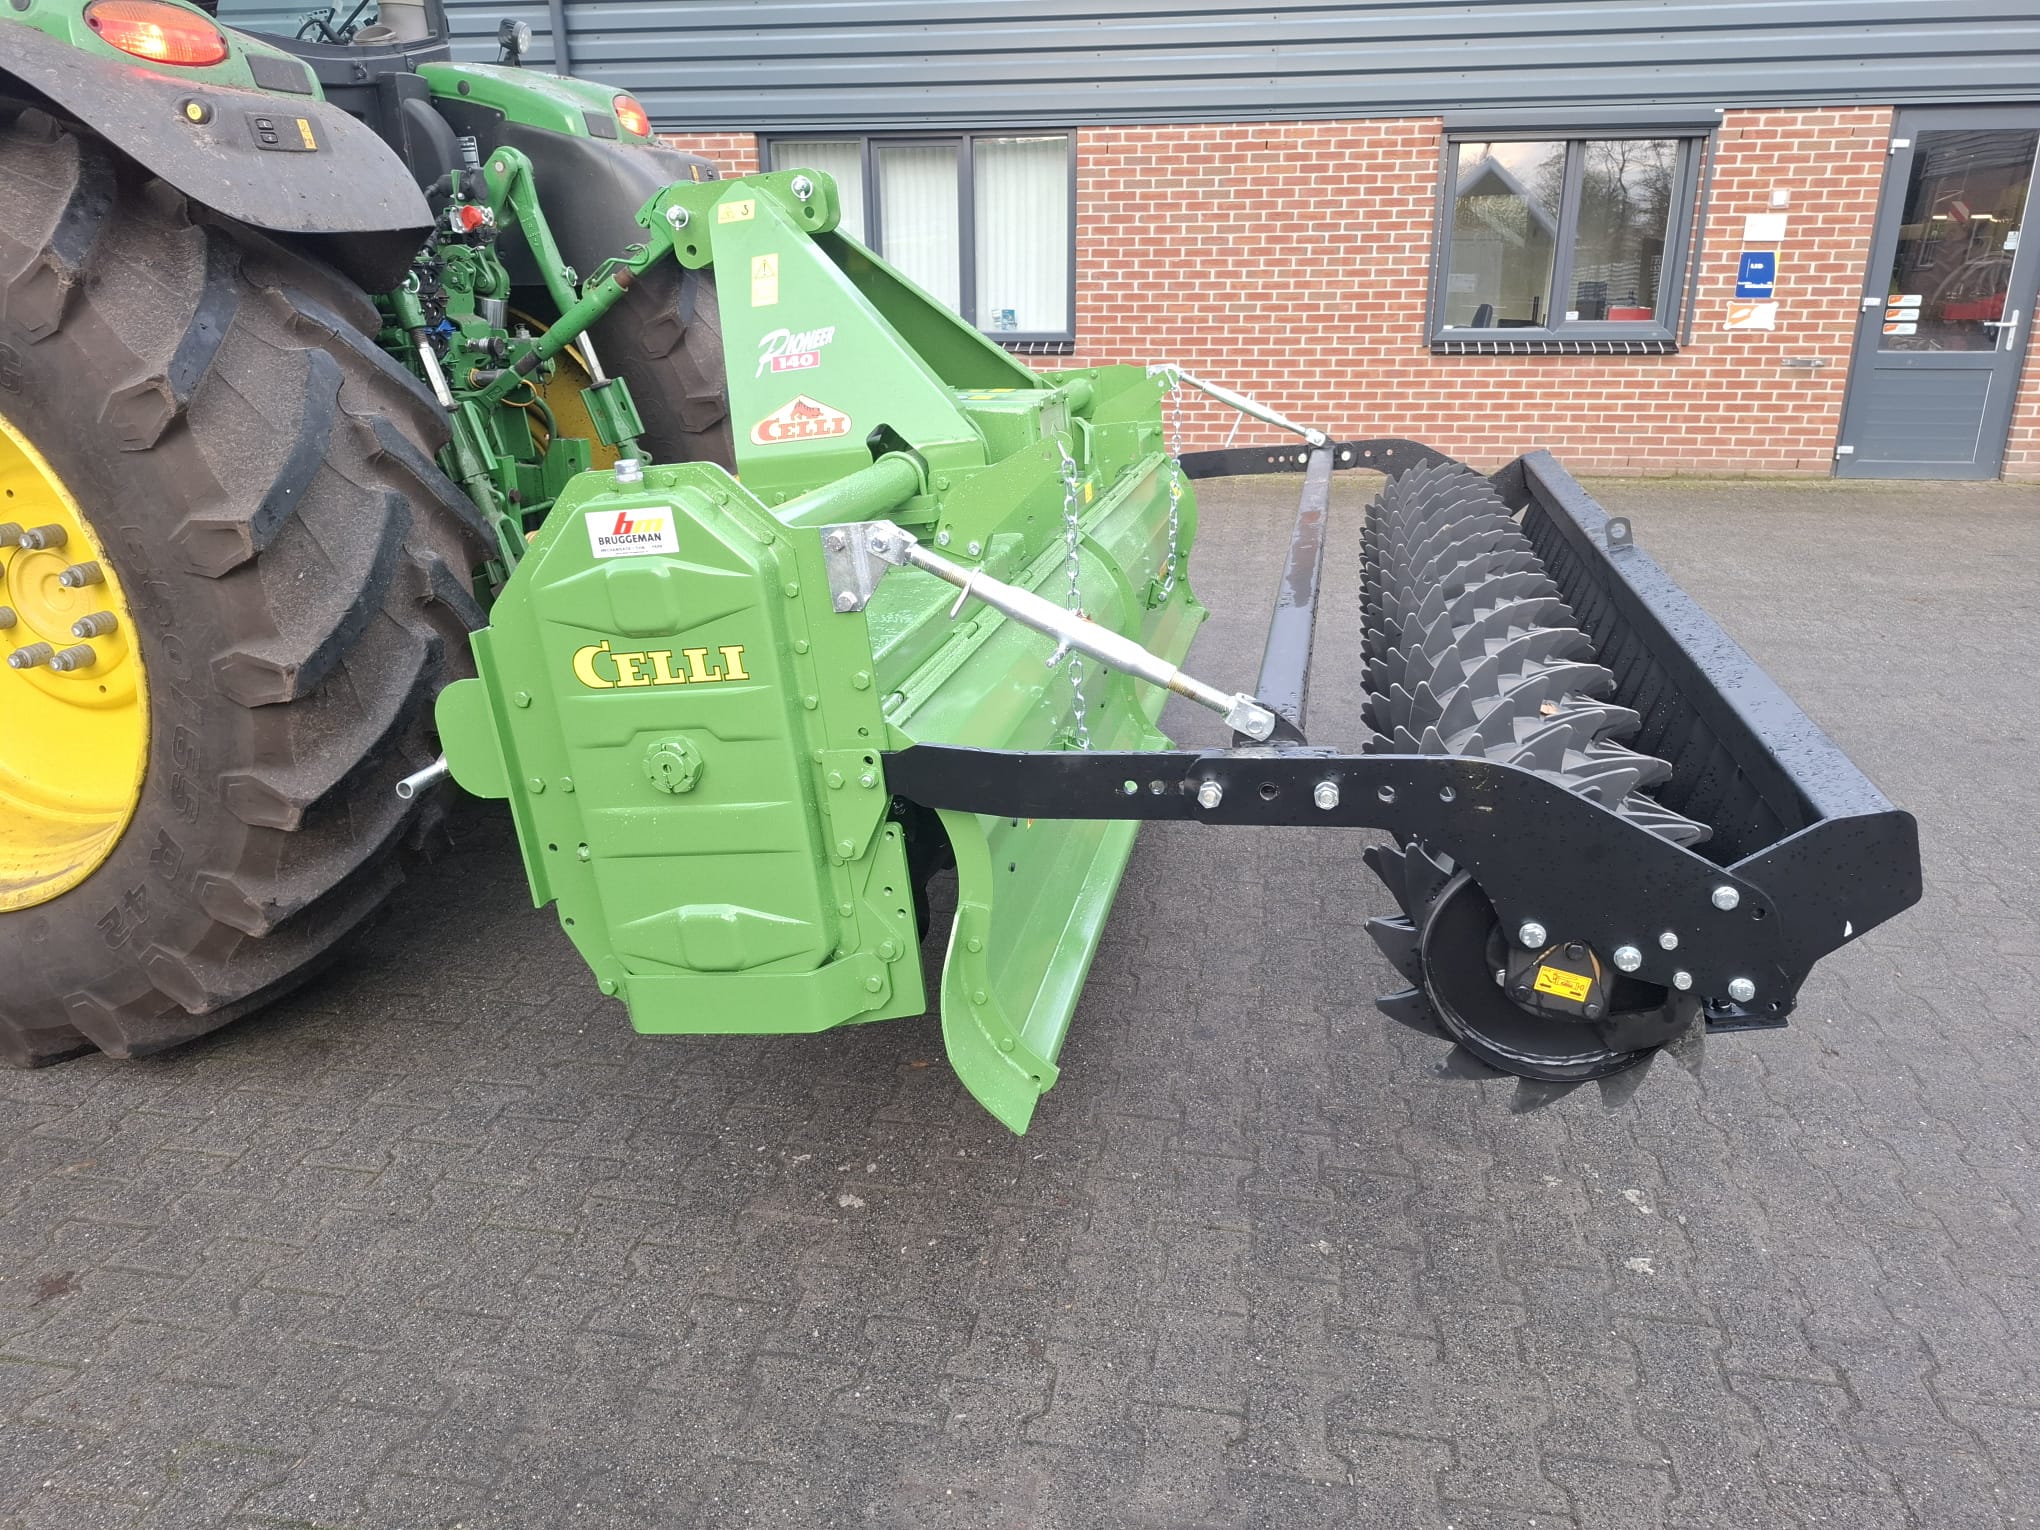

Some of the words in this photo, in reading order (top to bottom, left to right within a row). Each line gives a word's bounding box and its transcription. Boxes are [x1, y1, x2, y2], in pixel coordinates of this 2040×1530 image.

[755, 326, 835, 378] PIONEER
[778, 354, 814, 369] 140
[758, 418, 845, 441] CELLI
[598, 533, 662, 546] BRUGGEMAN
[573, 640, 750, 689] CELLI
[96, 881, 150, 950] 42
